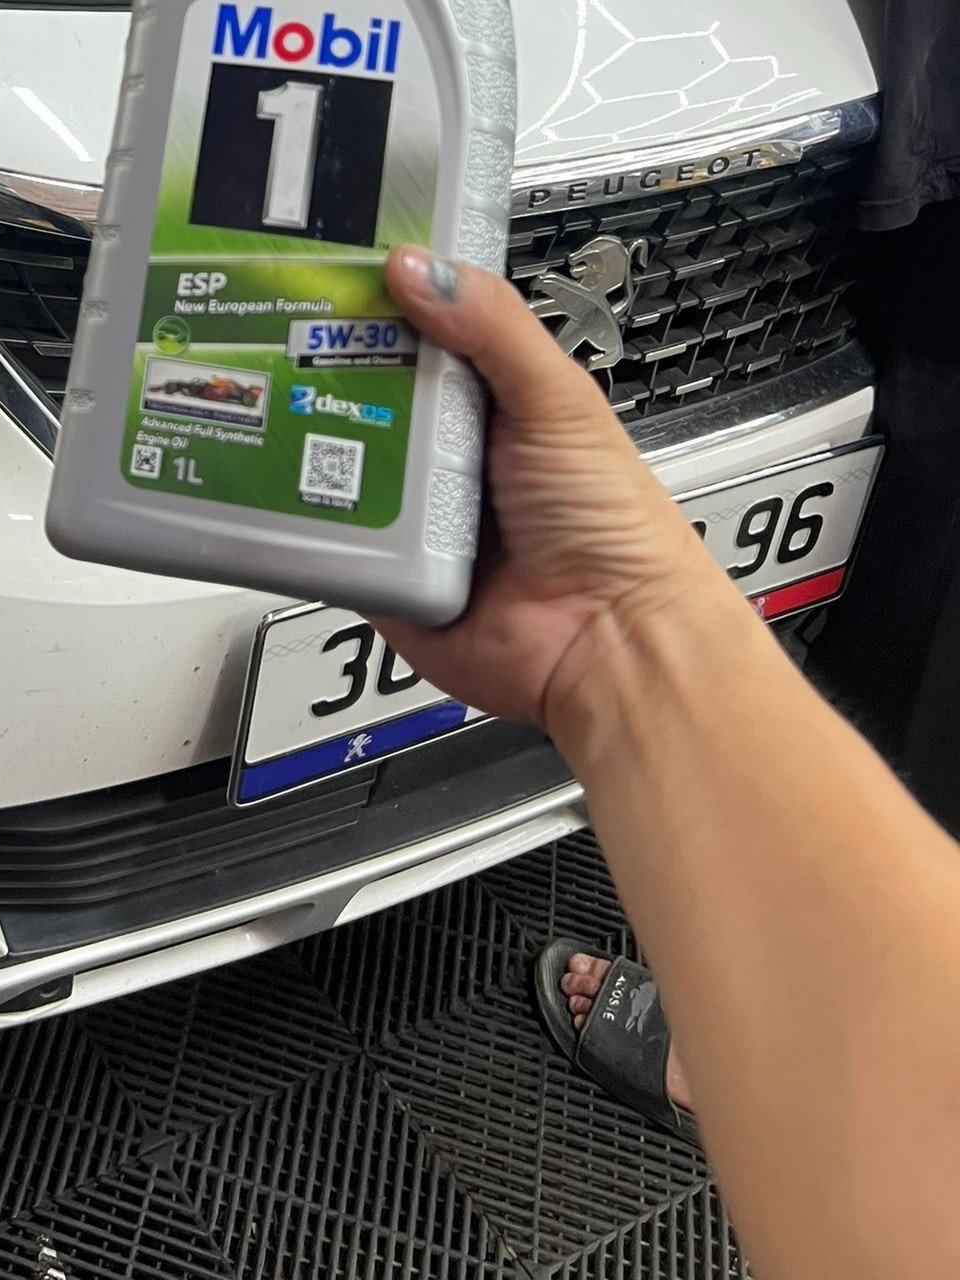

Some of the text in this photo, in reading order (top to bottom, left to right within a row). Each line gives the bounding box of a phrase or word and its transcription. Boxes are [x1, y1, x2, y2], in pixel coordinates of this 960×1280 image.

[211, 3, 402, 74] Mobil
[256, 80, 325, 230] 1
[527, 147, 762, 209] PEUGEOT
[177, 272, 228, 296] ESP
[174, 298, 333, 317] New European Formula
[306, 323, 399, 350] 5W-30
[136, 430, 188, 448] Engine Oil
[140, 416, 264, 446] Advanced Full Synthetic
[173, 456, 203, 485] 1L
[689, 481, 834, 580] 96
